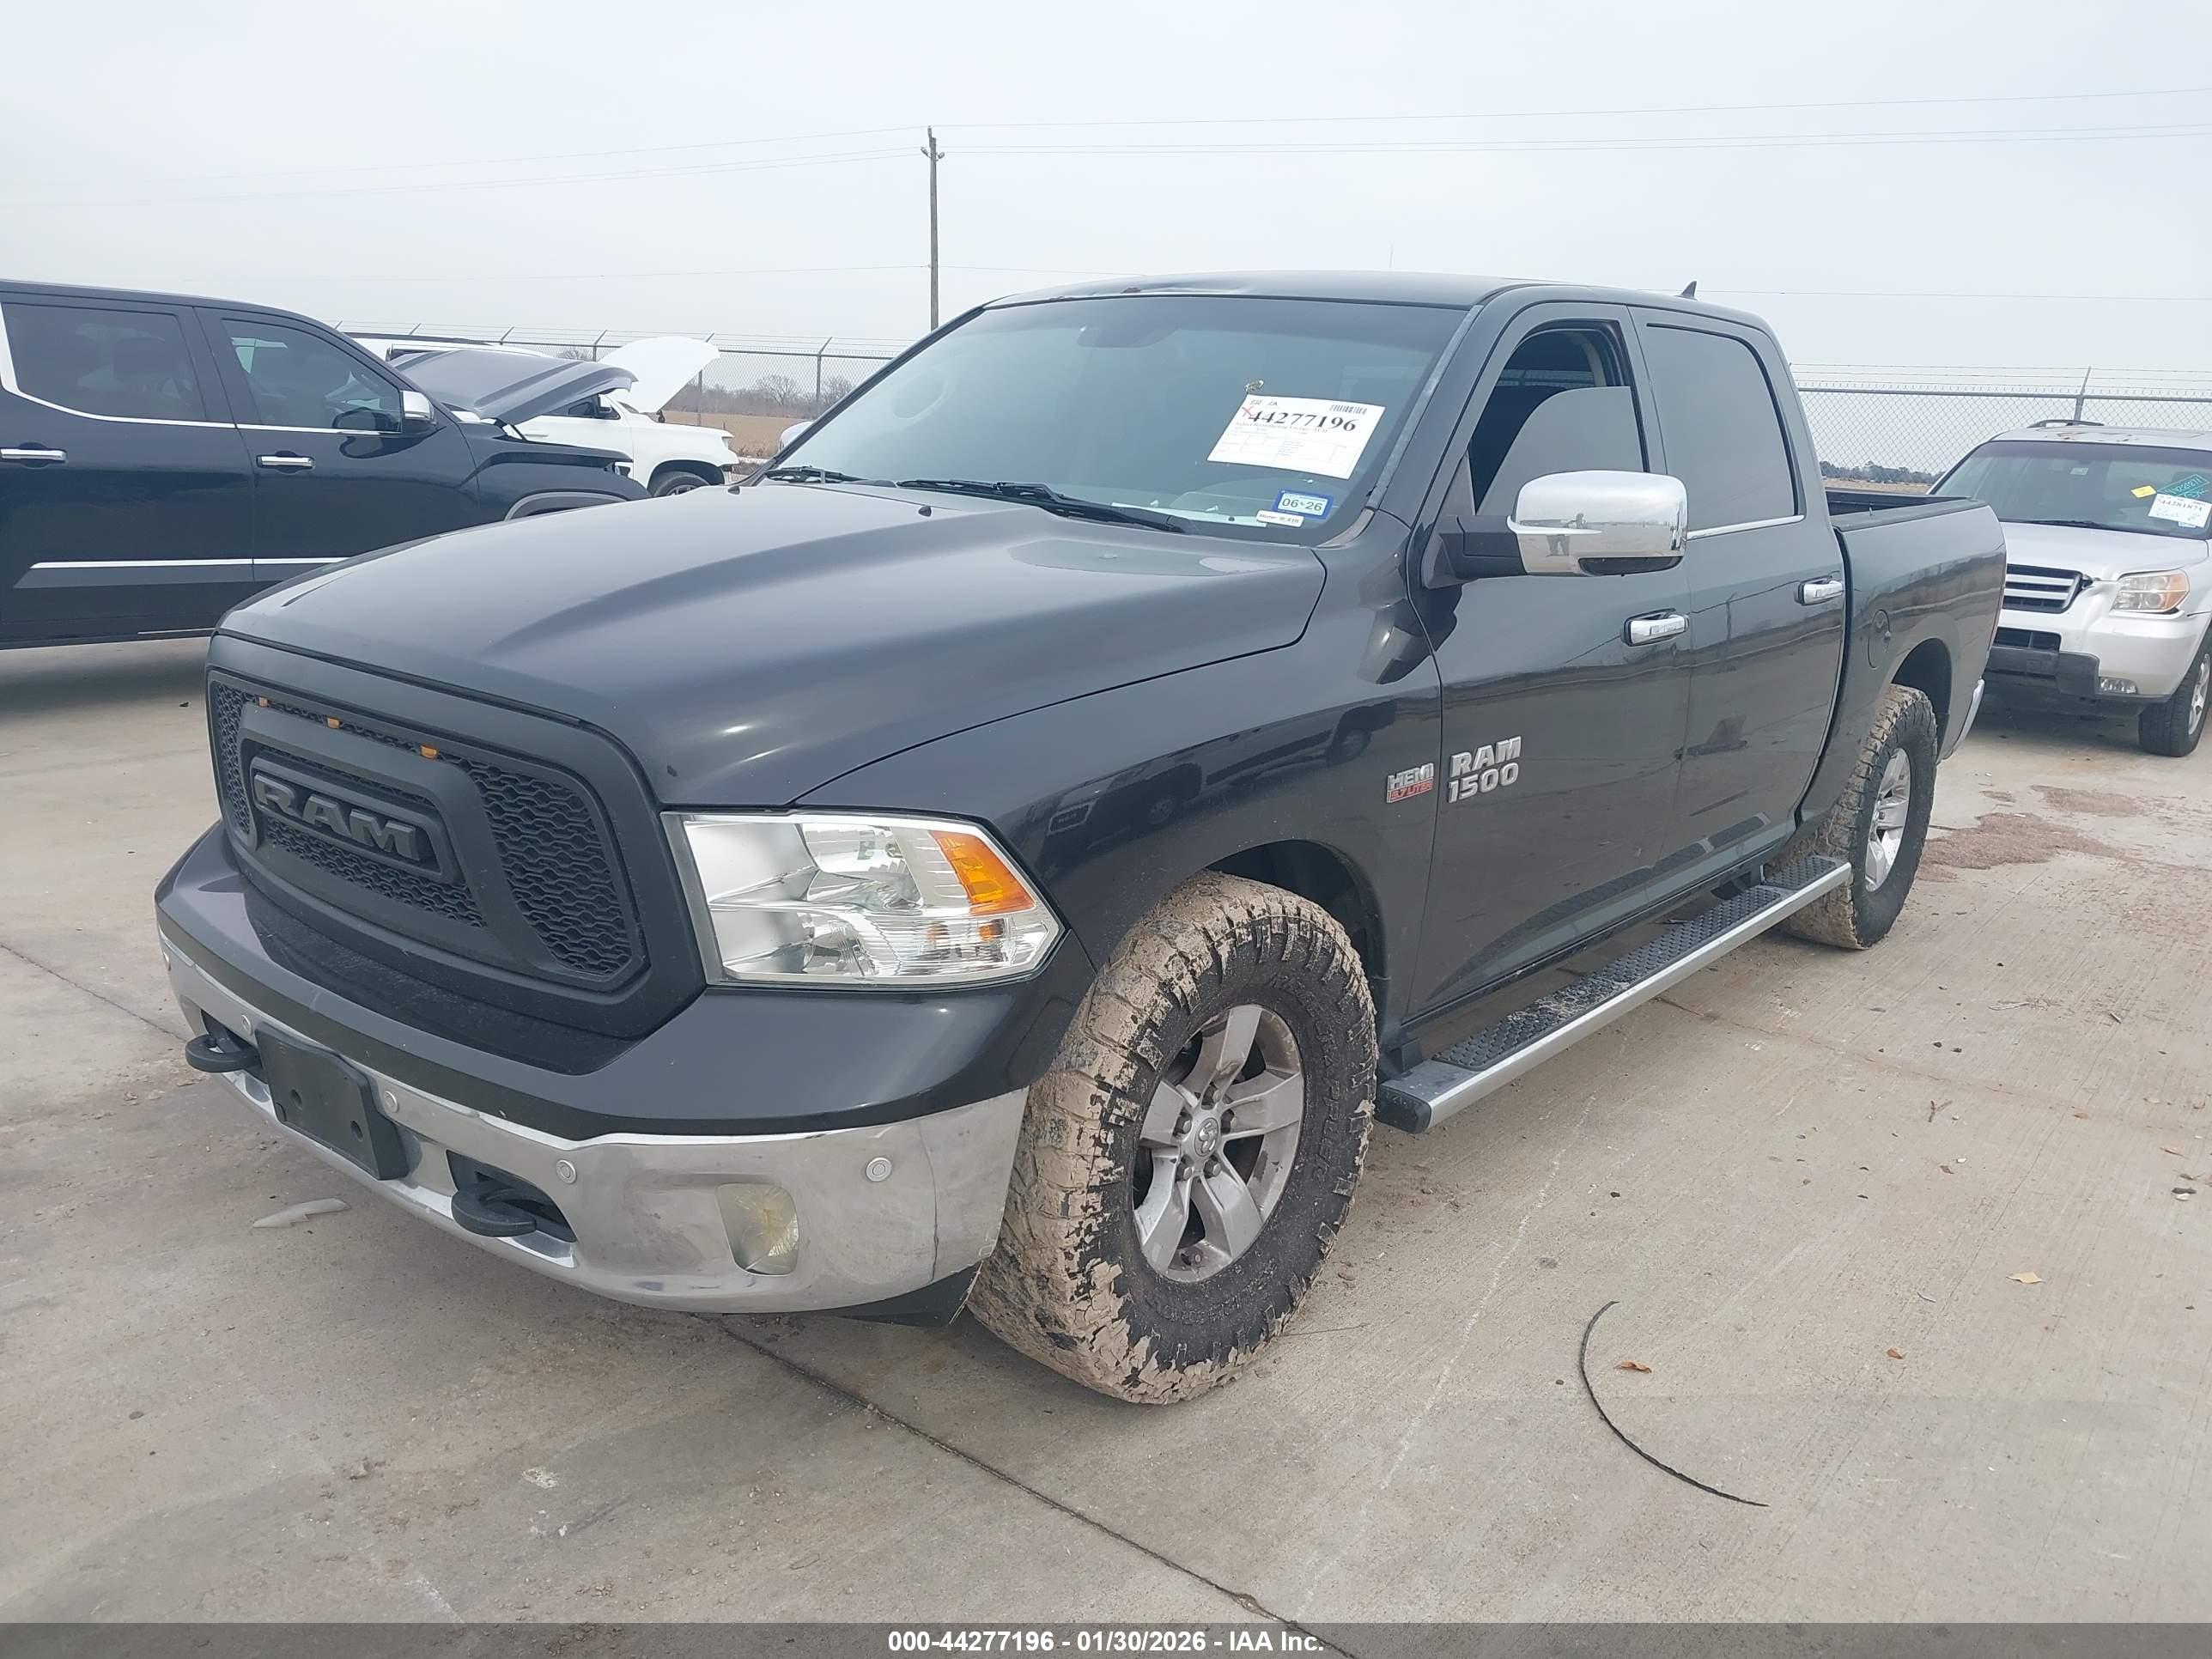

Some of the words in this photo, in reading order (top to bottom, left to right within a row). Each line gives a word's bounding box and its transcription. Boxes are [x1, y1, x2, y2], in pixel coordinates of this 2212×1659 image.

[1248, 410, 1360, 432] 44277196
[1281, 498, 1299, 508] 06
[1305, 501, 1323, 512] 26
[1449, 736, 1522, 778] RAM
[1387, 763, 1434, 790] HEMI
[1448, 763, 1519, 804] 1500
[254, 774, 418, 861] RAM
